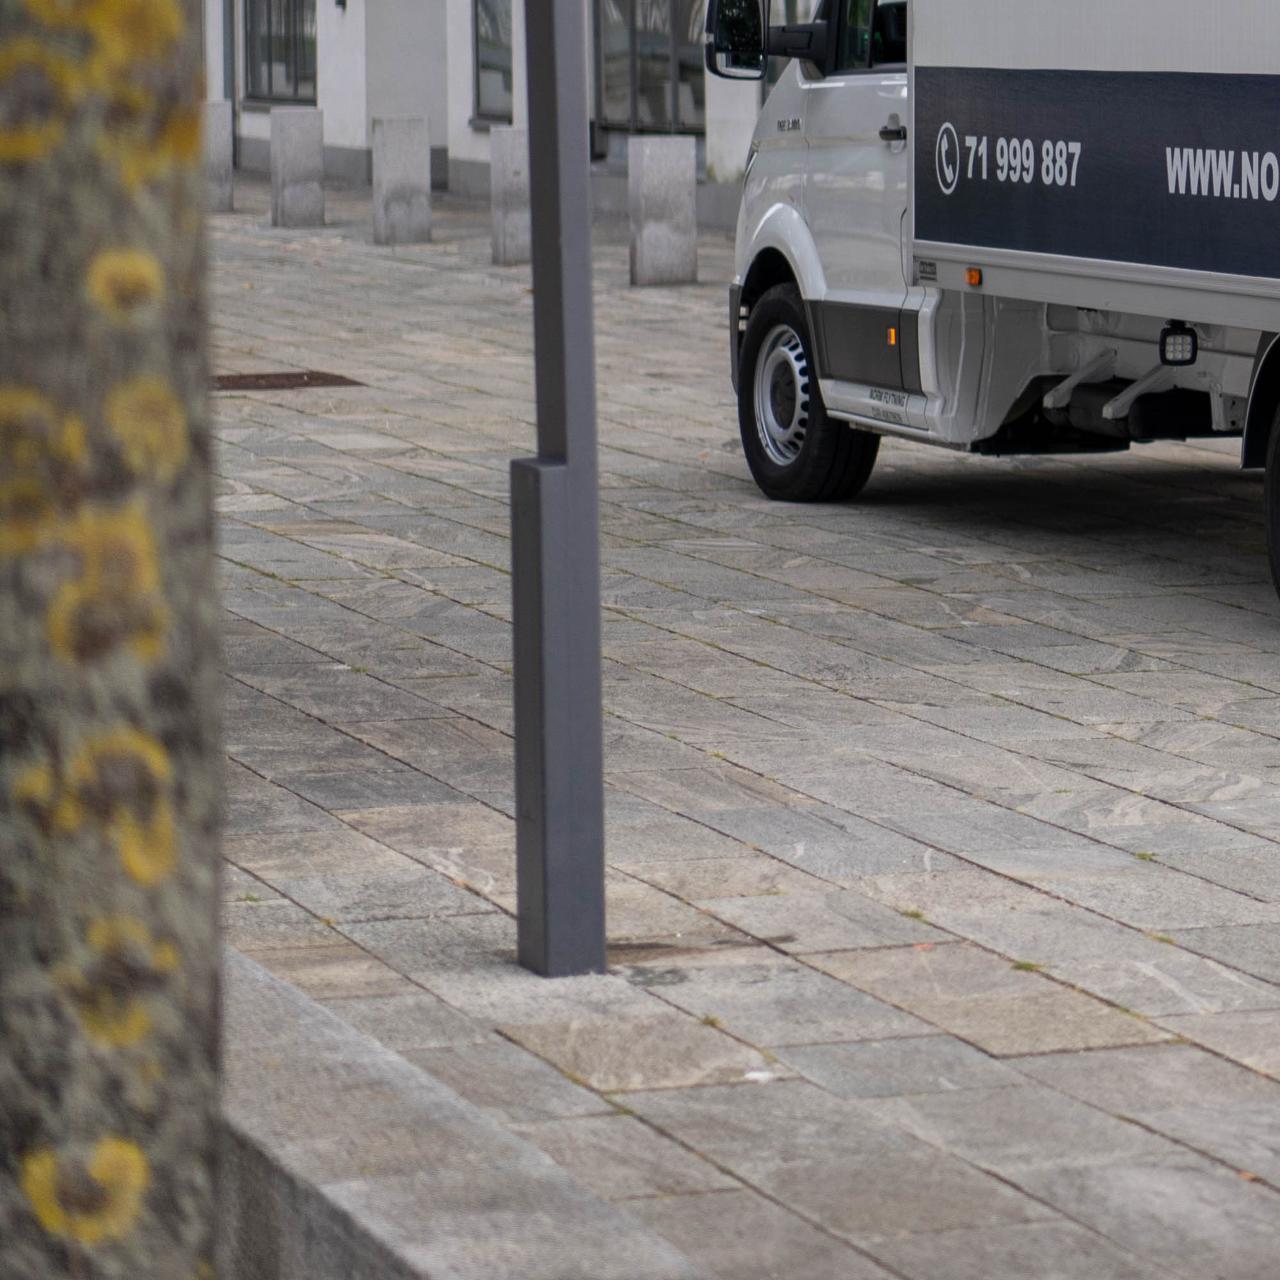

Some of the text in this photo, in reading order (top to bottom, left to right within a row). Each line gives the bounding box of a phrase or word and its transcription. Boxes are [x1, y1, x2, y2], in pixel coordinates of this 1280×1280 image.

[965, 135, 1082, 187] 71 999 887
